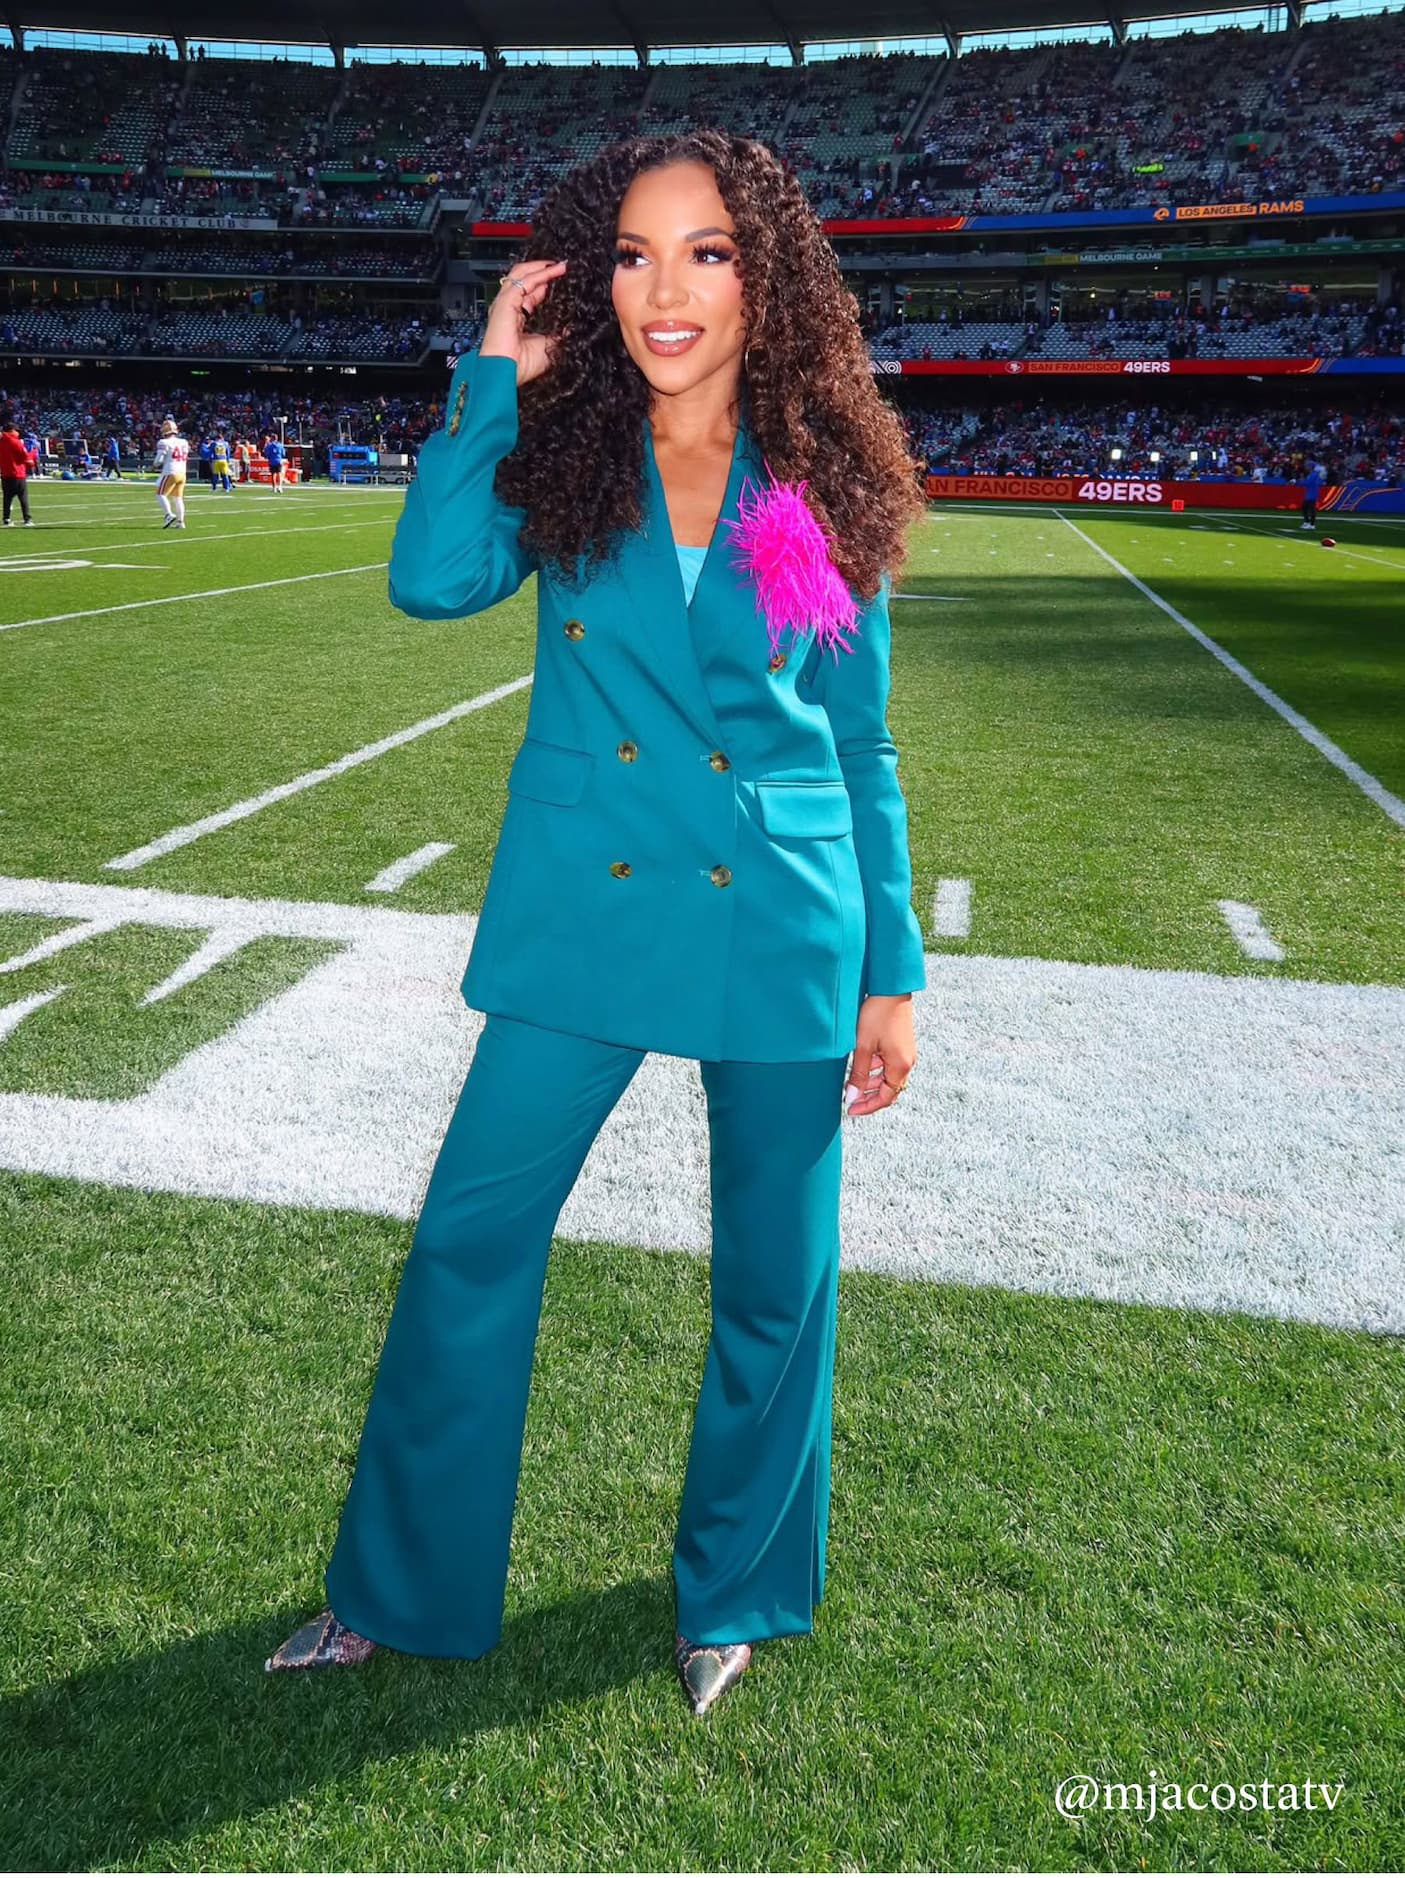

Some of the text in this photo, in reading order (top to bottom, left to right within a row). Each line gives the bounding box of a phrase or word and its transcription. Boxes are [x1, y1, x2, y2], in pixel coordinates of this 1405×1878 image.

[1178, 200, 1304, 217] LOS ANGELES RAMS
[122, 215, 189, 227] CRICKET
[198, 219, 236, 228] CLUB
[1136, 252, 1163, 261] GAME
[1030, 362, 1051, 372] SAN
[1055, 362, 1120, 372] FRANCISCO
[1123, 361, 1171, 373] 49ERS
[955, 479, 1069, 496] FRANCISCO
[1078, 481, 1162, 502] 49ERS
